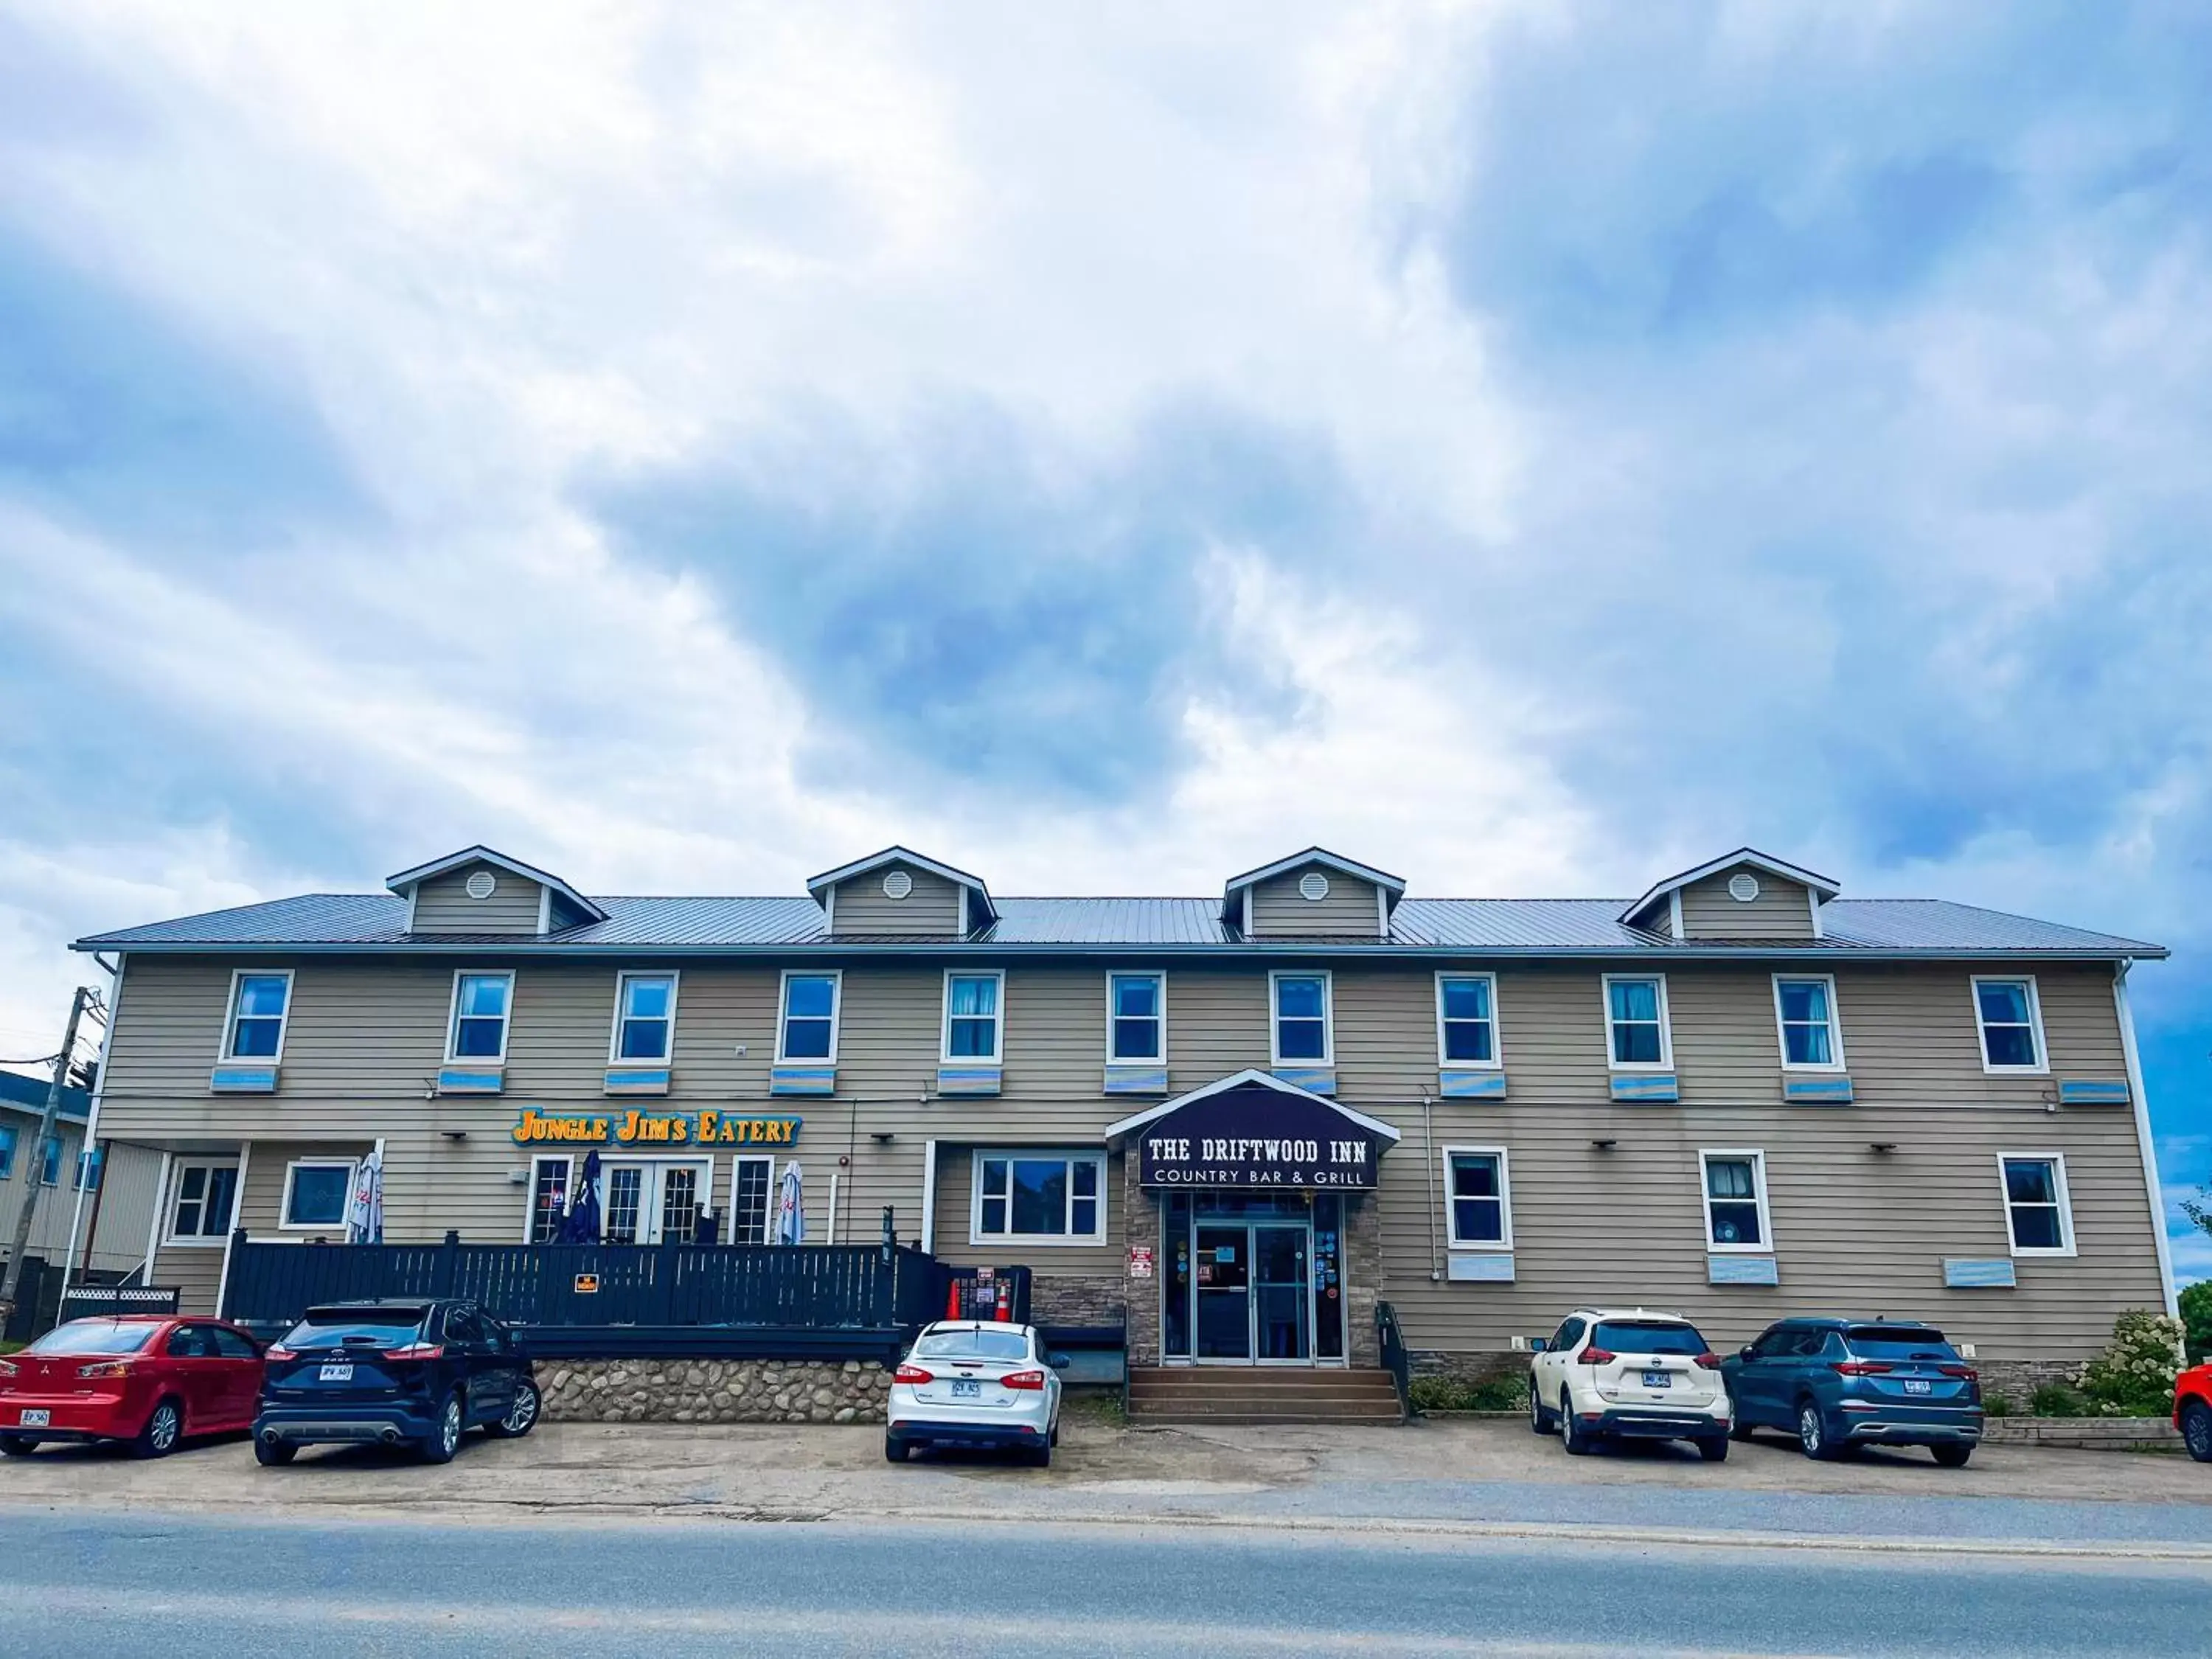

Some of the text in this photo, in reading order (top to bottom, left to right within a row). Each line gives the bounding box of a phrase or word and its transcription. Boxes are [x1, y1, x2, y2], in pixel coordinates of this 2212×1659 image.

[514, 1110, 797, 1142] JUNGLE JIM'S EATERY
[1150, 1138, 1366, 1163] THE DRIFTWOOD INN
[1155, 1170, 1363, 1184] COUNTRY BAR & GRILL
